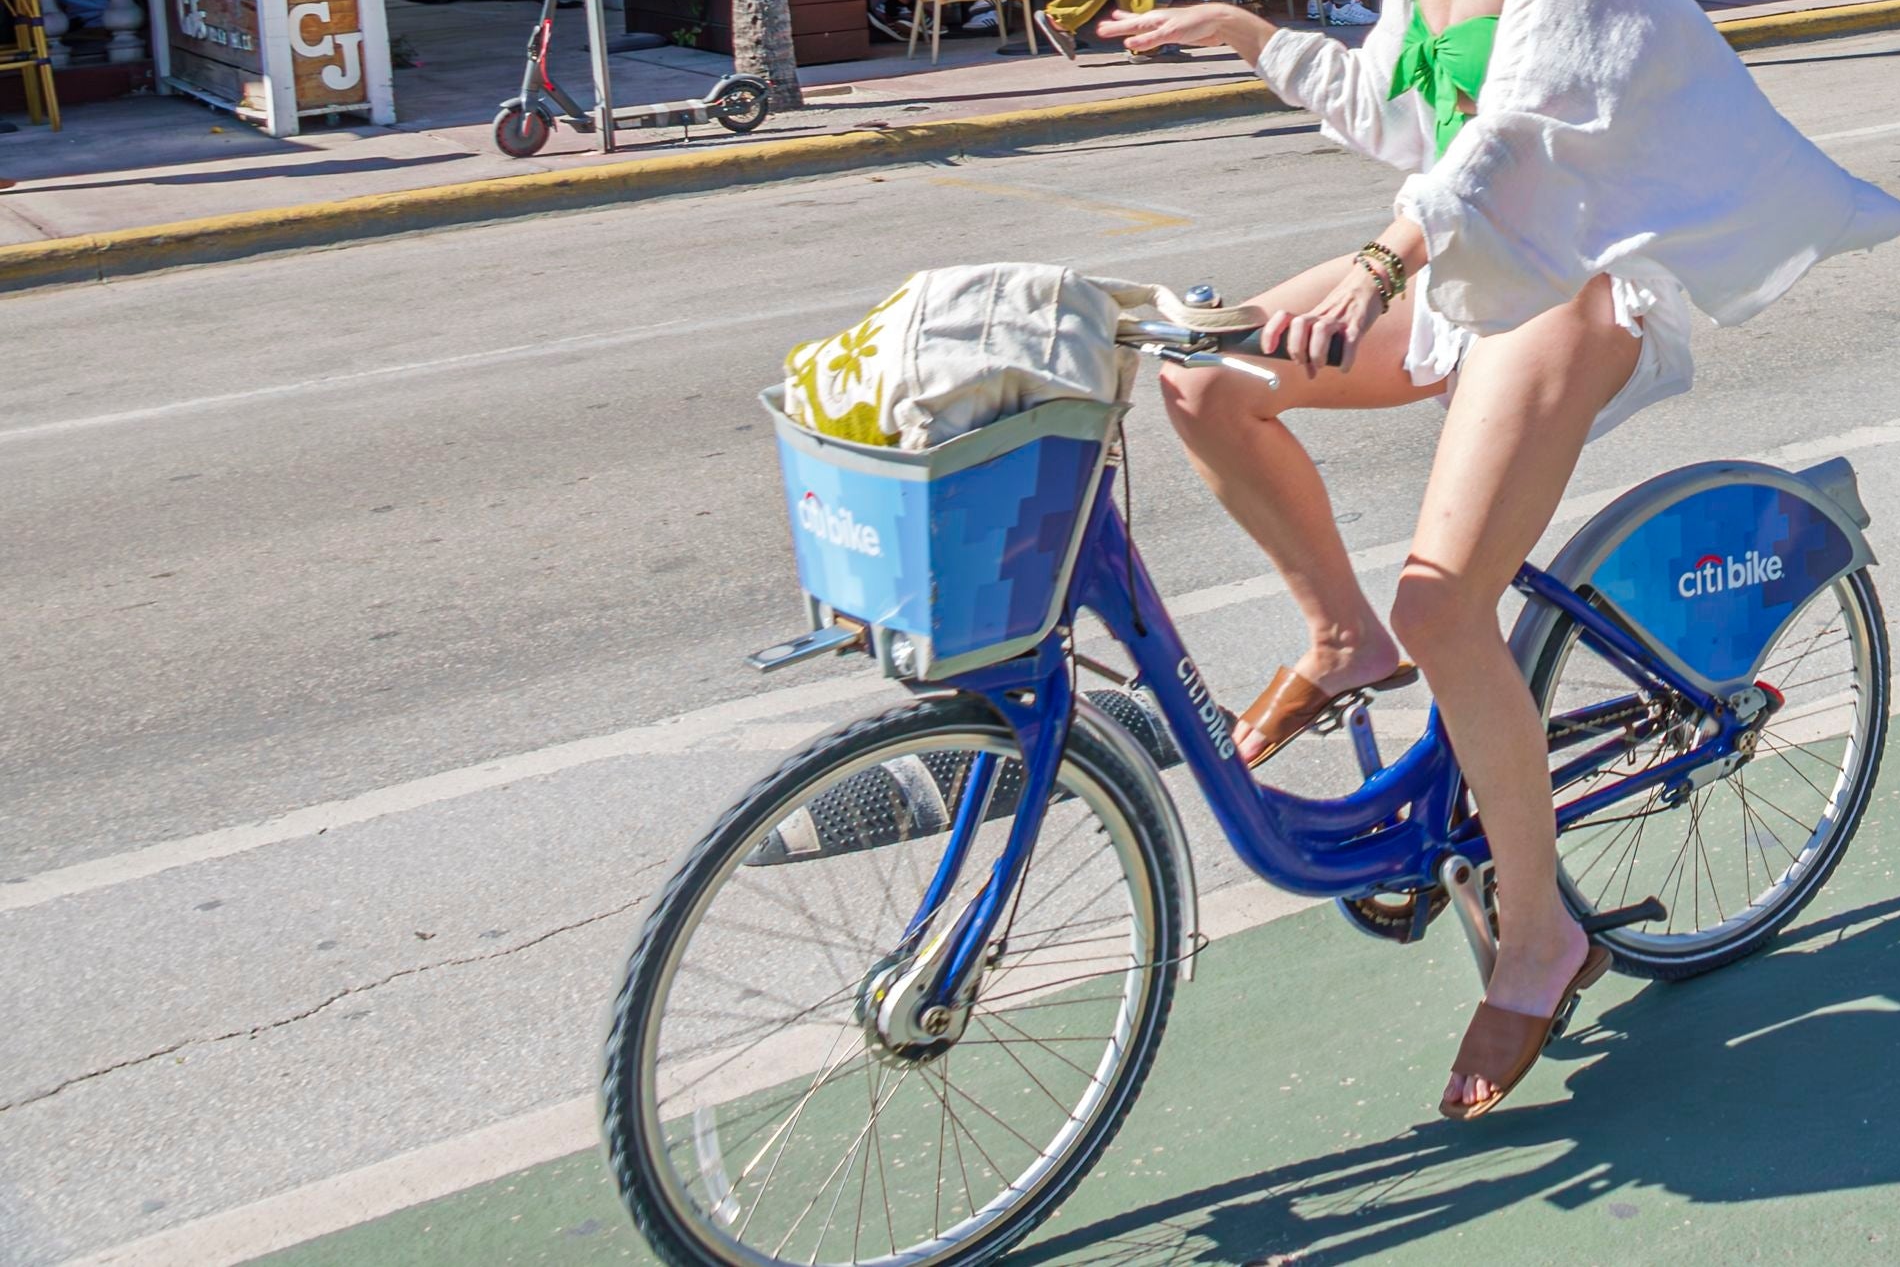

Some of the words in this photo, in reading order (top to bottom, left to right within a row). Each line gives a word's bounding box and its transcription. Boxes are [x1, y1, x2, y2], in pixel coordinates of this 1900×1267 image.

[827, 507, 881, 557] bike
[1678, 554, 1724, 598] citi
[1727, 550, 1783, 590] bike
